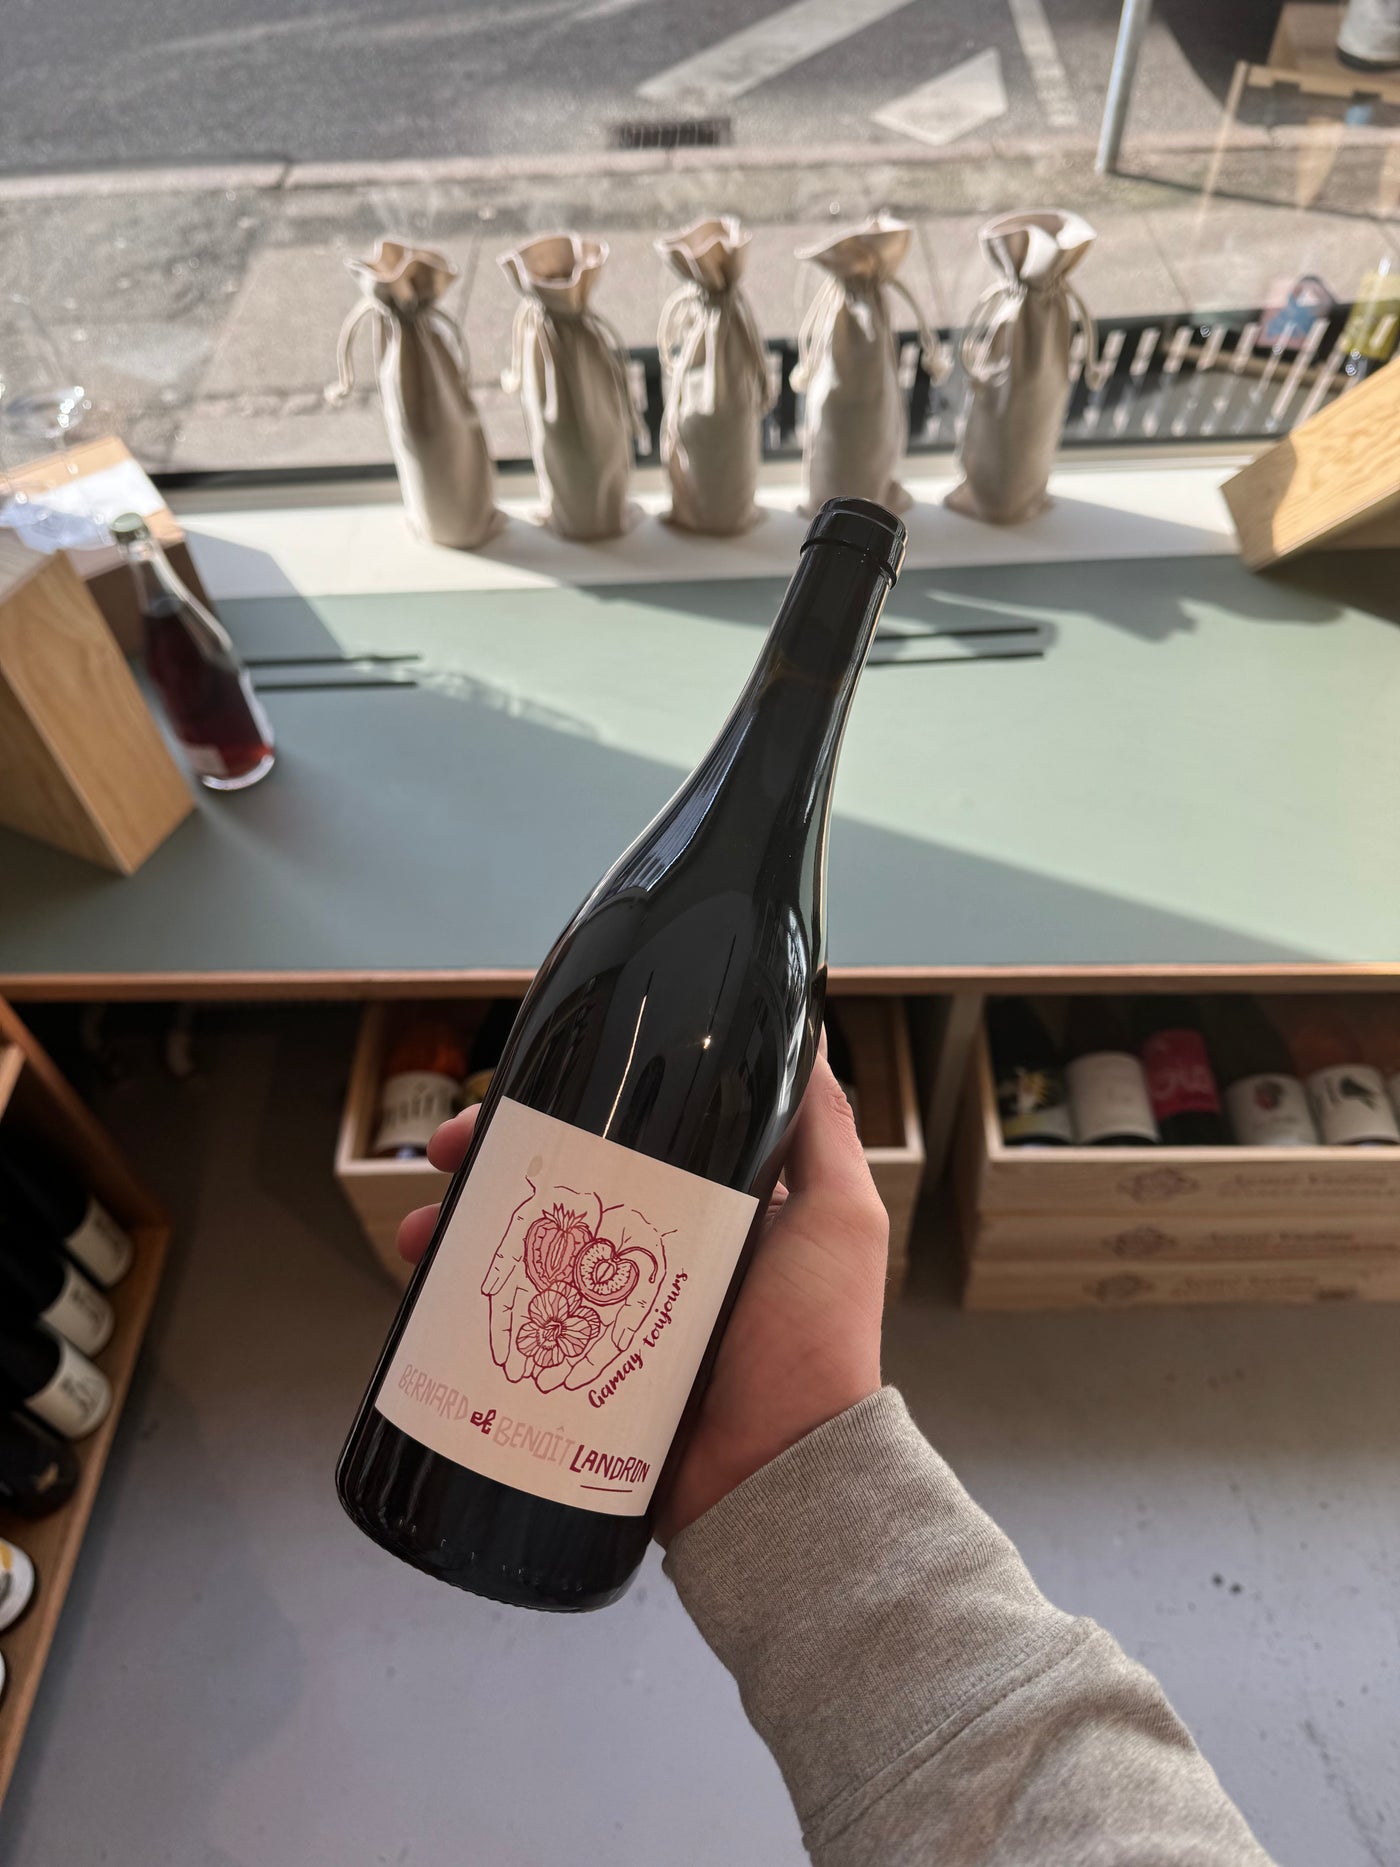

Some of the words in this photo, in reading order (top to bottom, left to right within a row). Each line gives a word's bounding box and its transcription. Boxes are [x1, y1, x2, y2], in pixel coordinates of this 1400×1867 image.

[588, 1349, 643, 1408] Gamay
[643, 1268, 688, 1348] toujours
[398, 1364, 469, 1421] BERNARD
[470, 1409, 497, 1435] et
[493, 1416, 576, 1466] BENOÎT
[569, 1444, 651, 1484] LANDRON
